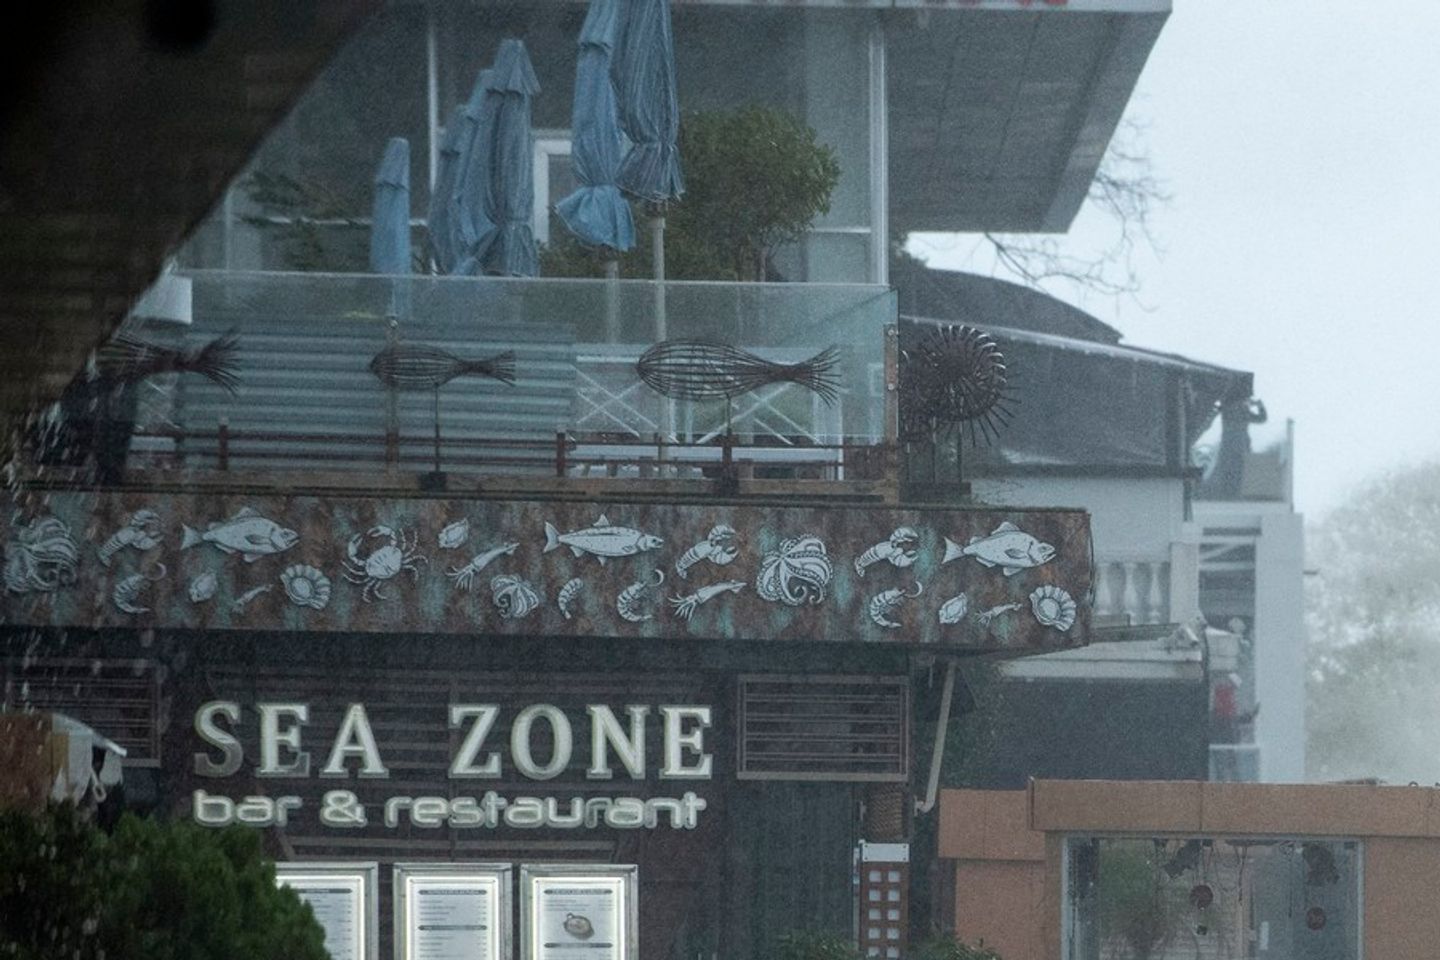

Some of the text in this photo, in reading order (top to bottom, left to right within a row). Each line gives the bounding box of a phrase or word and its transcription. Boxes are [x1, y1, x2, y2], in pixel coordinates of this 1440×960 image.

[193, 700, 713, 780] SEA ZONE
[193, 788, 707, 829] bar & restaurant
